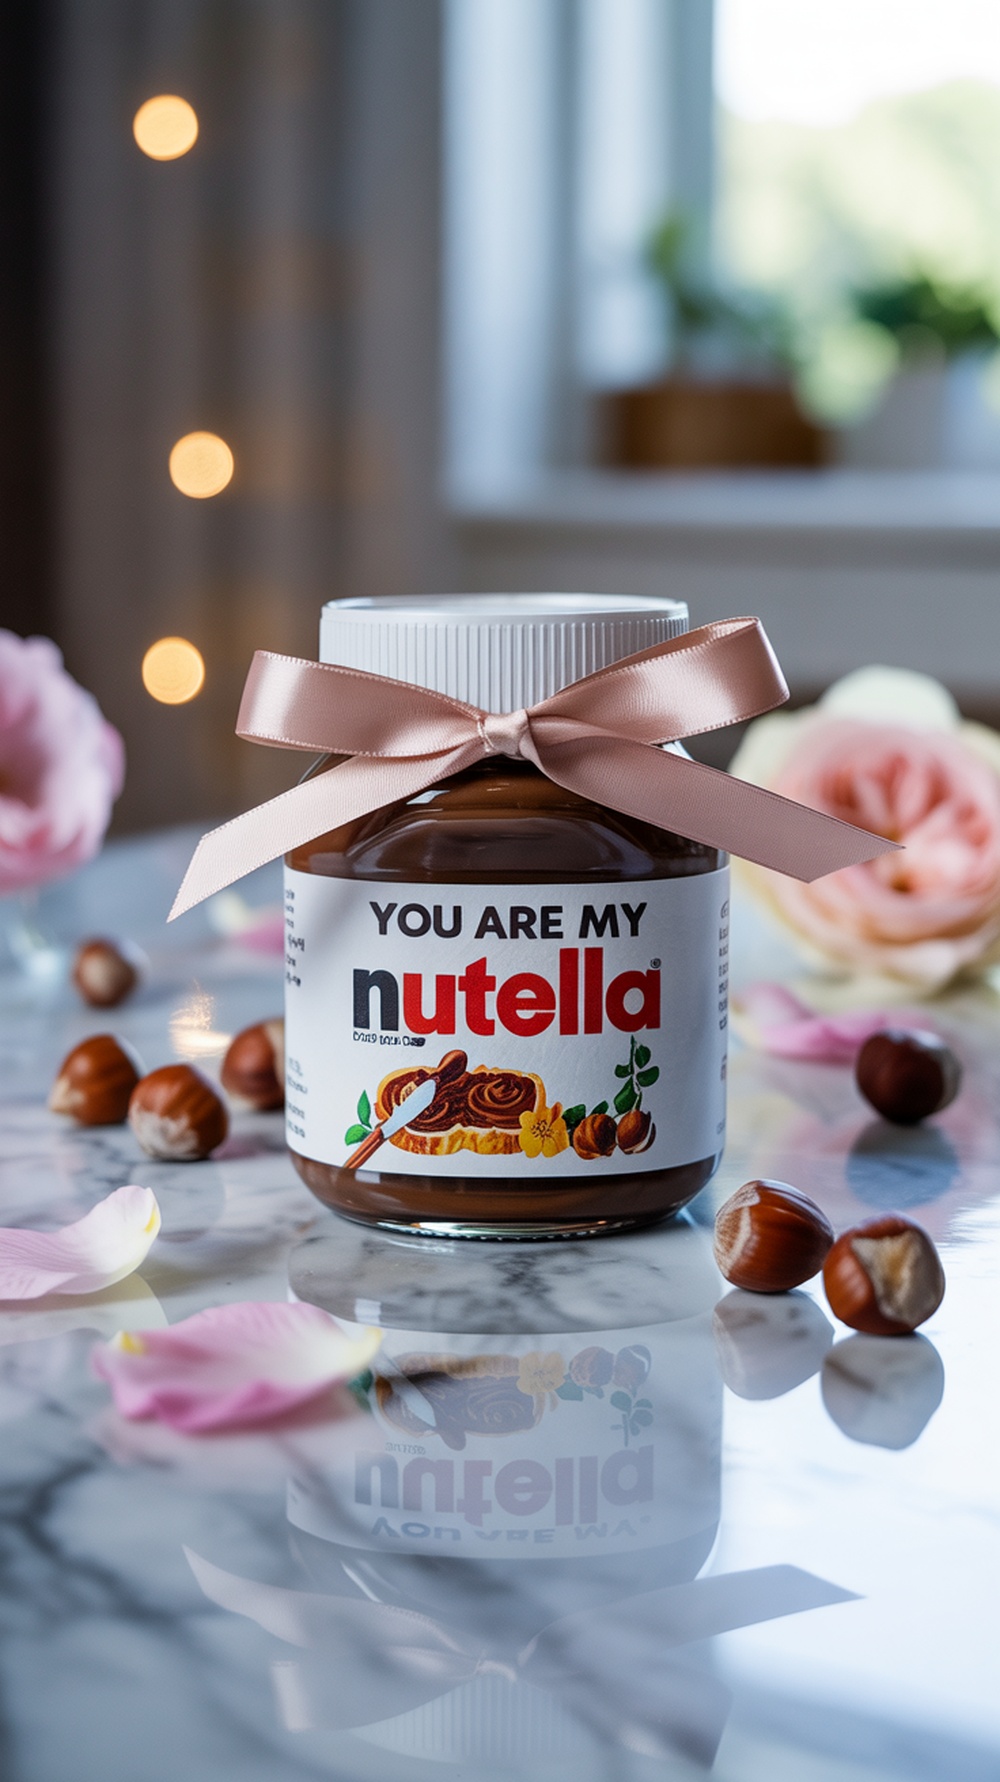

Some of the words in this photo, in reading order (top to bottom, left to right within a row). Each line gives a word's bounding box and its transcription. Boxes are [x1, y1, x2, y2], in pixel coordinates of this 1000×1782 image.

[369, 901, 463, 939] YOU
[474, 905, 563, 940] ARE
[578, 902, 648, 939] MY
[352, 947, 661, 1037] nutella
